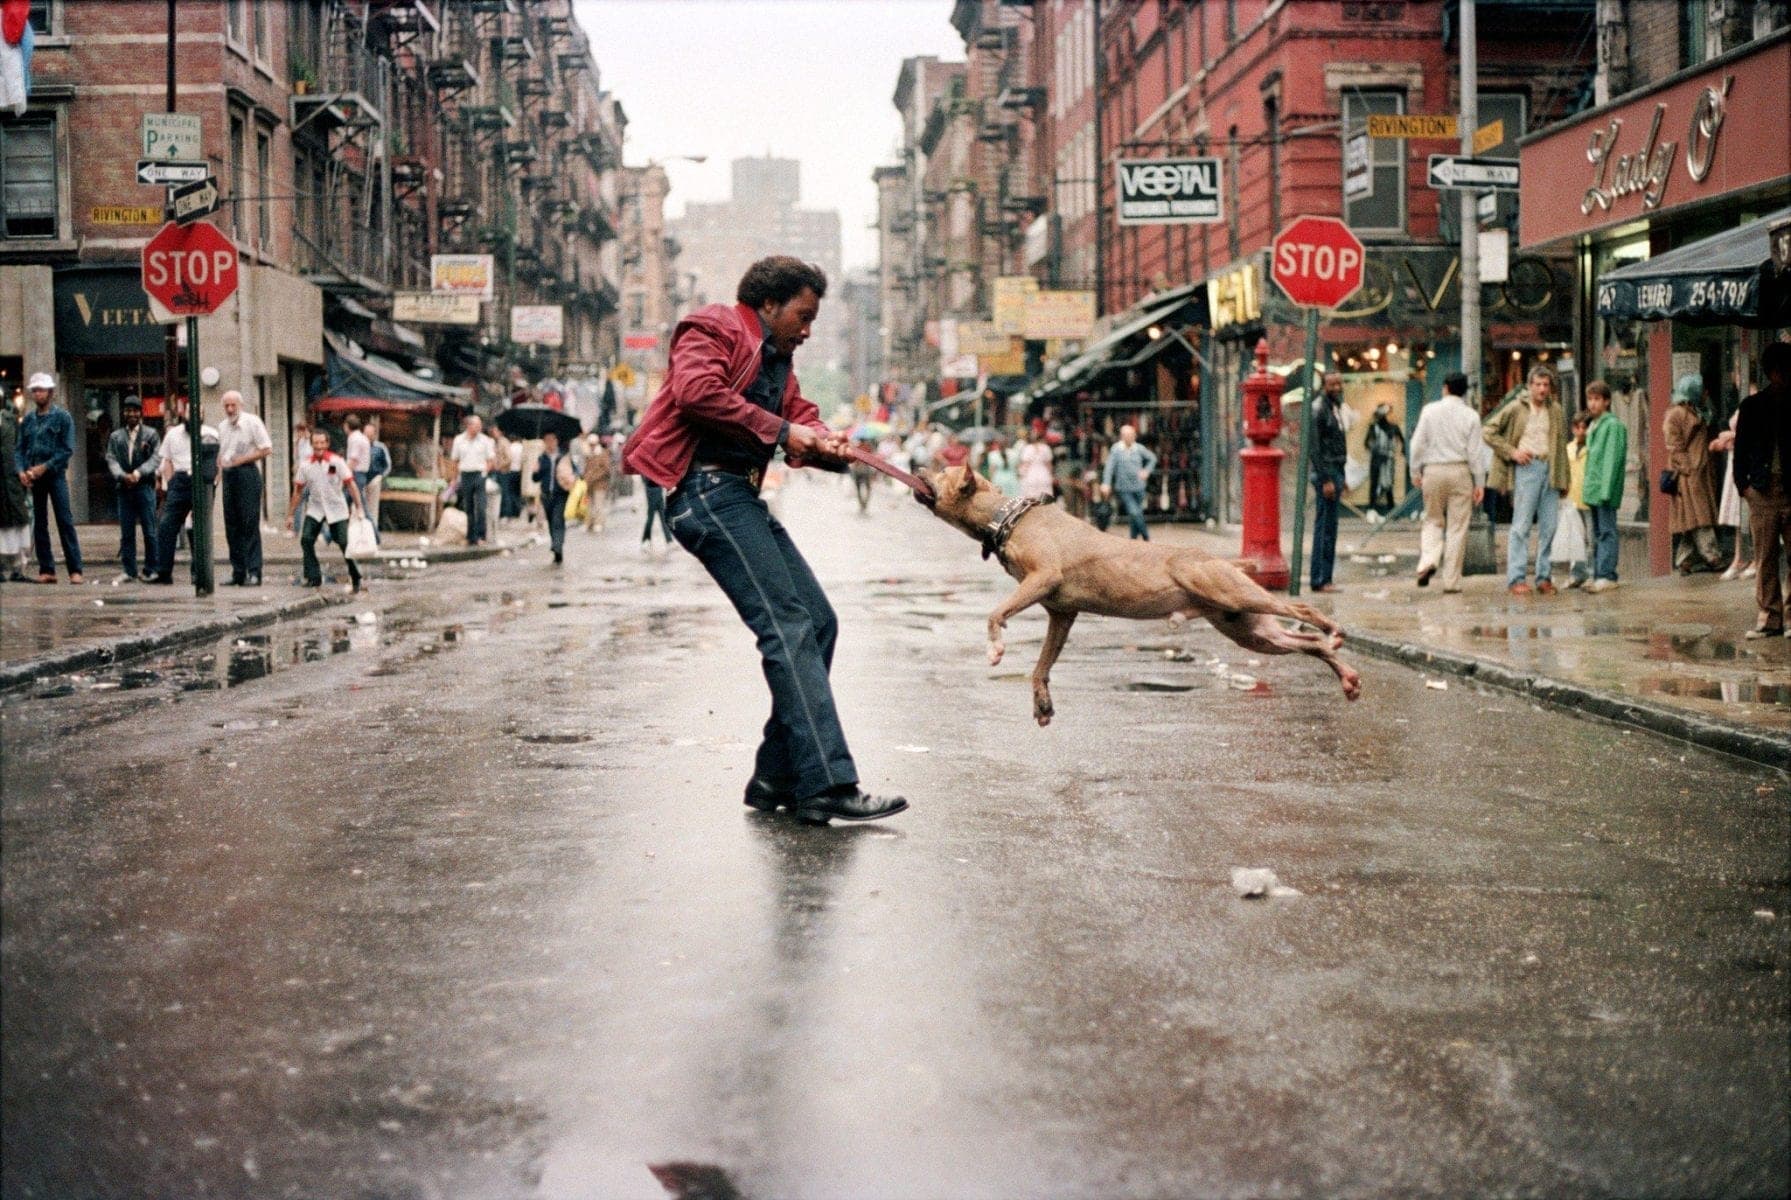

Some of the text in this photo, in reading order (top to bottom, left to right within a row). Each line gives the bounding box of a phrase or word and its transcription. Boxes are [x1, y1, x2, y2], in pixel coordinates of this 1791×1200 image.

[147, 118, 197, 128] MUNICIPAL
[1370, 116, 1446, 134] RIVINGTON
[147, 130, 200, 154] PARKING
[1581, 103, 1677, 215] Lady
[147, 168, 202, 177] ONE WAY
[1441, 166, 1513, 177] ONE WAY
[178, 196, 192, 210] ONE
[93, 207, 147, 221] RIVINGTON
[149, 250, 233, 286] STOP
[1277, 242, 1359, 281] STOP
